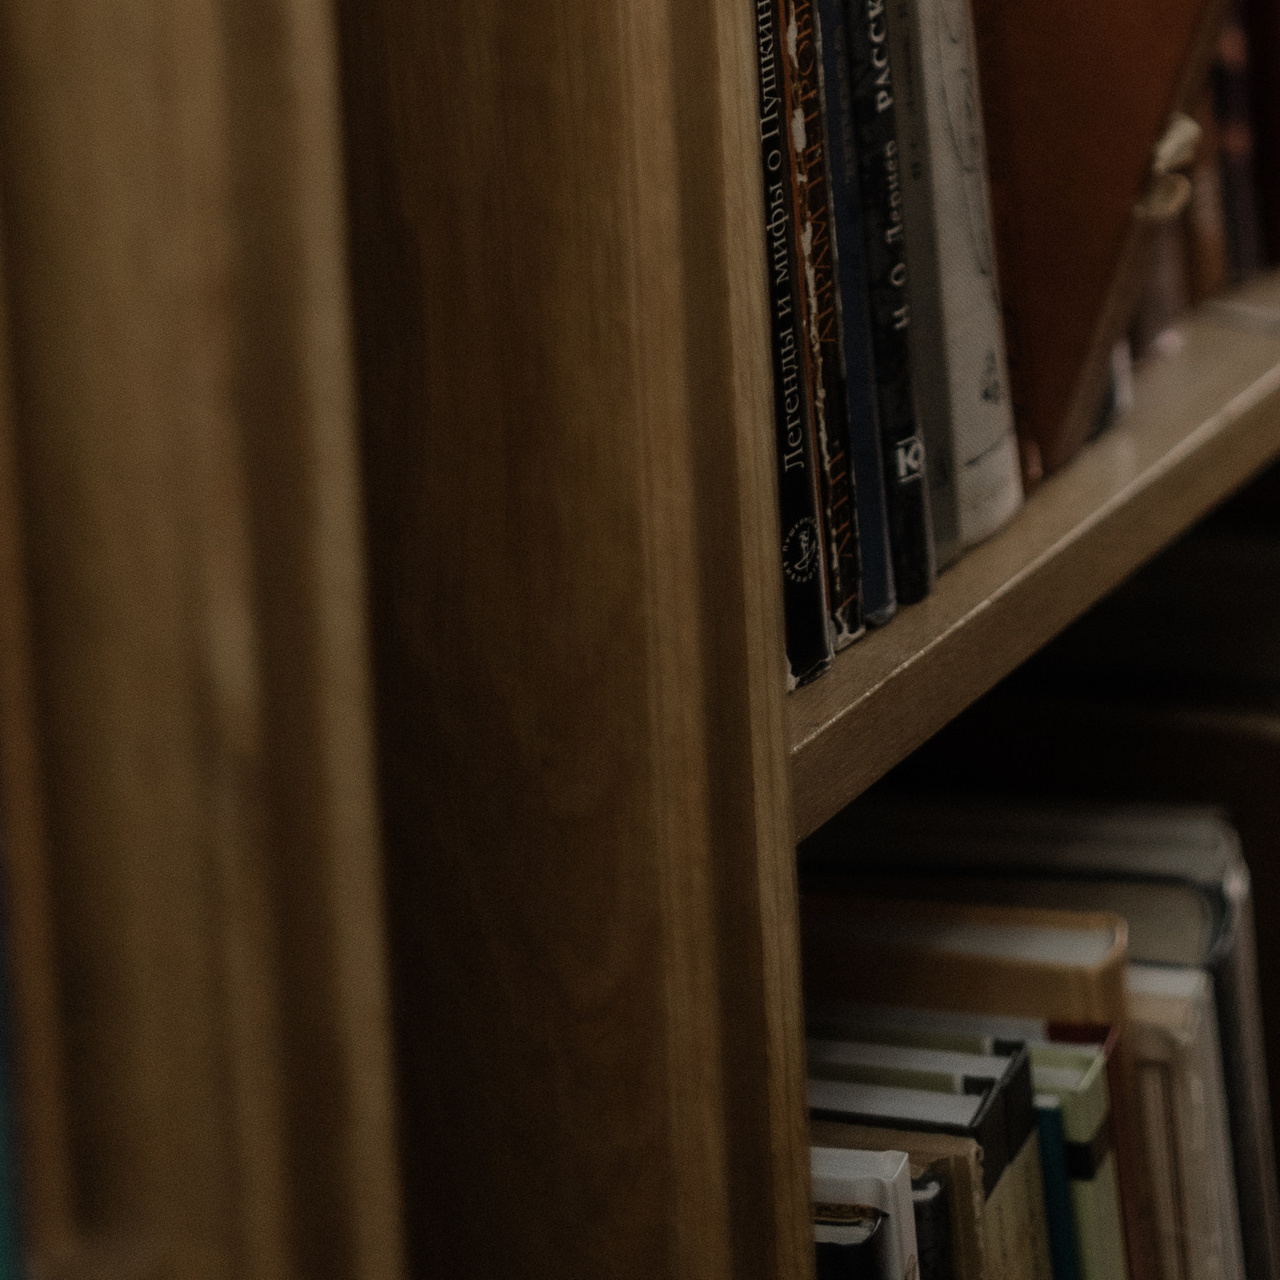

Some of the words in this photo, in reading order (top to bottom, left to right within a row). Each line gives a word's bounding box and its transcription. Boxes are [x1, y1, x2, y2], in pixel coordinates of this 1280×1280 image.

[767, 148, 782, 172] о
[765, 181, 792, 286] мифы
[806, 206, 838, 346] АБРАМ
[777, 295, 791, 319] и
[779, 327, 806, 474] Легенды
